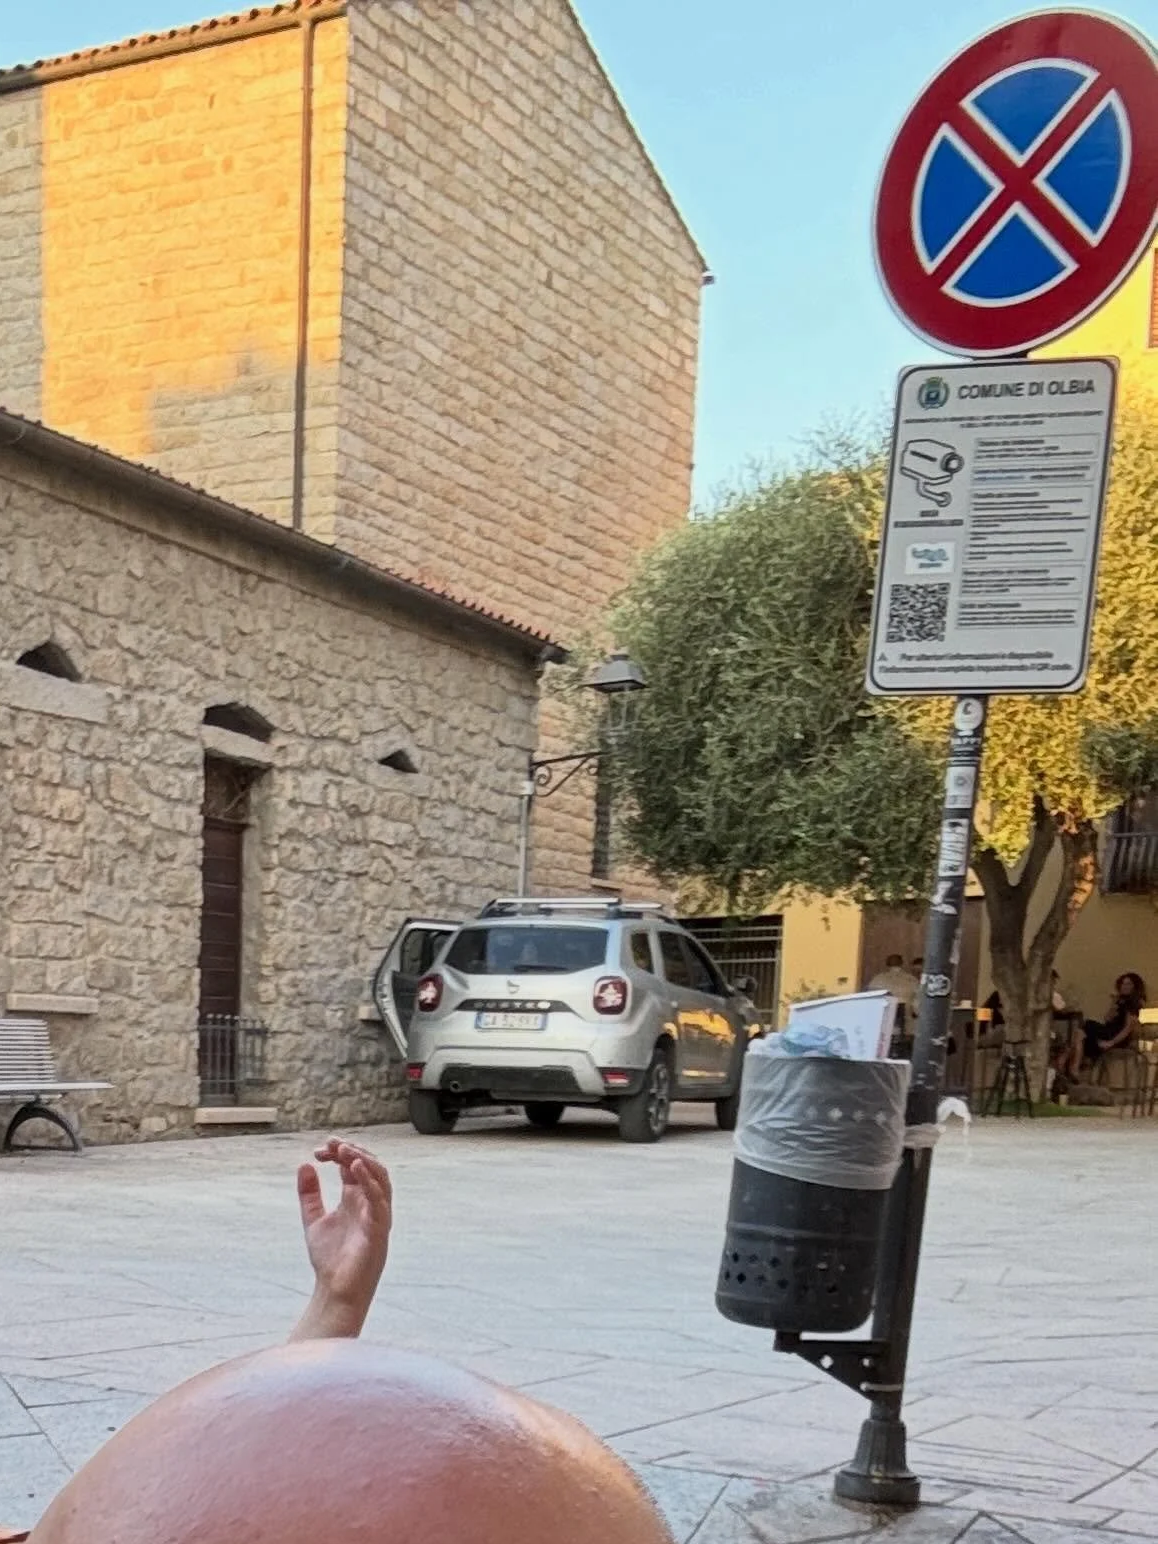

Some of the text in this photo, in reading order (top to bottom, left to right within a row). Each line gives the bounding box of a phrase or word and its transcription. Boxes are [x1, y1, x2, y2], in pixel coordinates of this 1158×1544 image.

[958, 379, 1095, 399] COMUNE DI OLBIA
